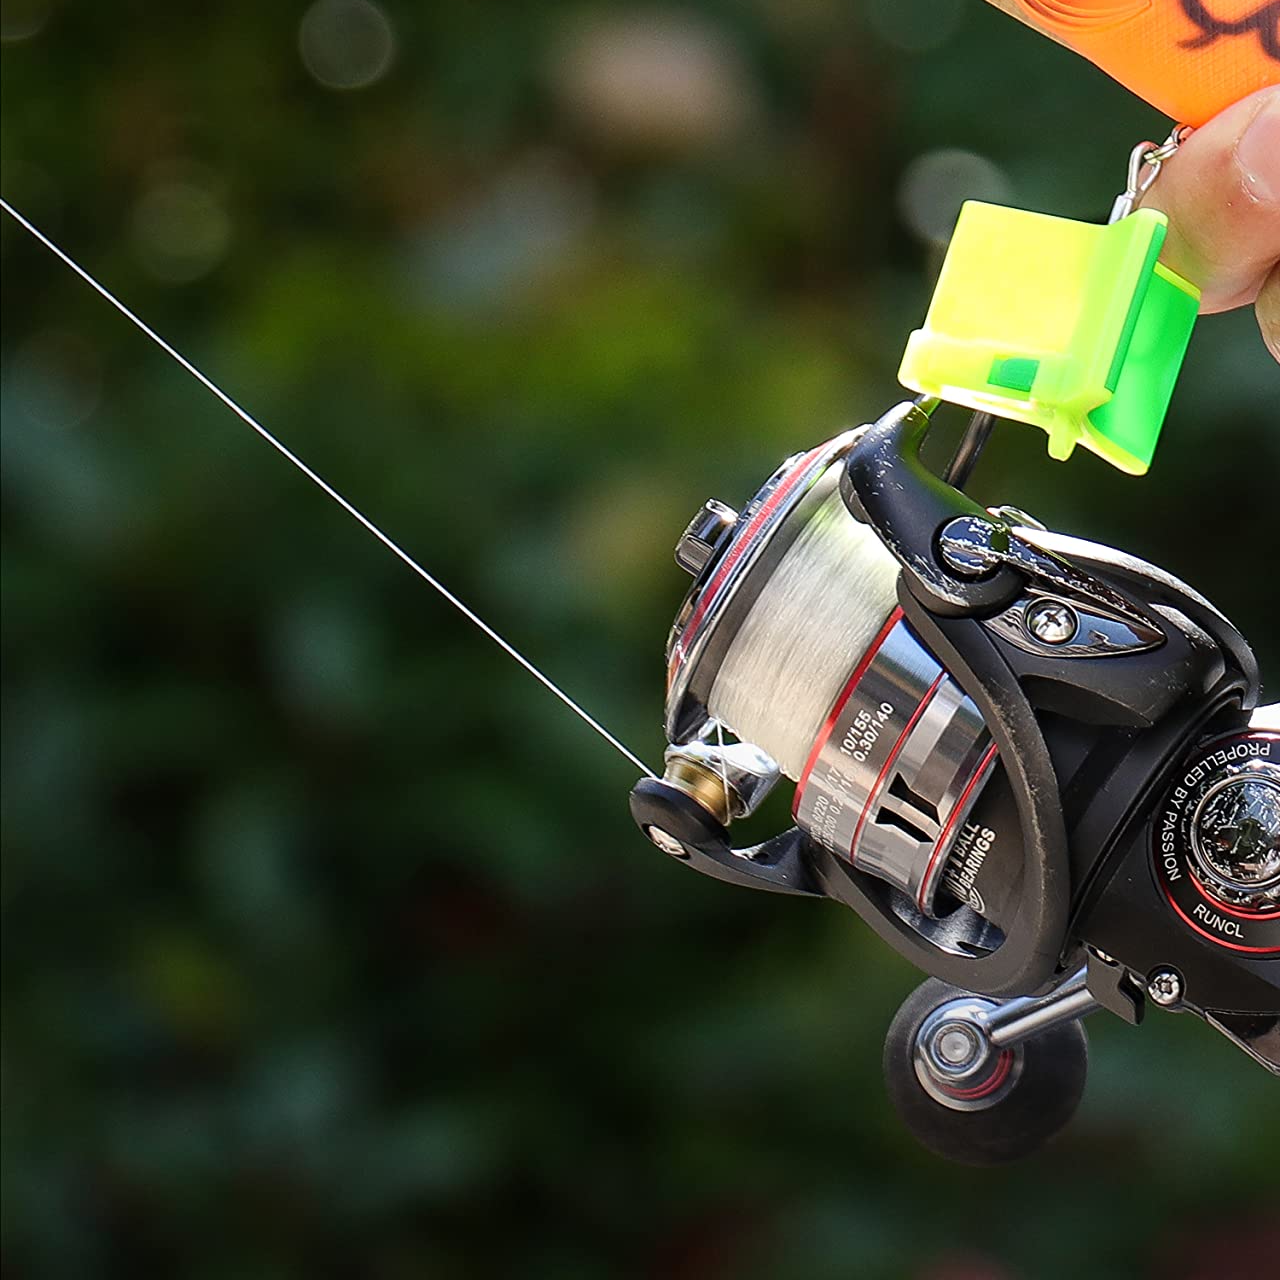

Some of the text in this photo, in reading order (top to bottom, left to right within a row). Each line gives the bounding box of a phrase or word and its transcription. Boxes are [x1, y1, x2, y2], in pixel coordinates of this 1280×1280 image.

[840, 709, 871, 756] 10/155
[853, 702, 894, 762] 0.30/140
[1161, 742, 1271, 882] PROPELLED BY PASSION
[959, 828, 996, 890] BEARINGS
[1192, 903, 1244, 938] RUNCL
